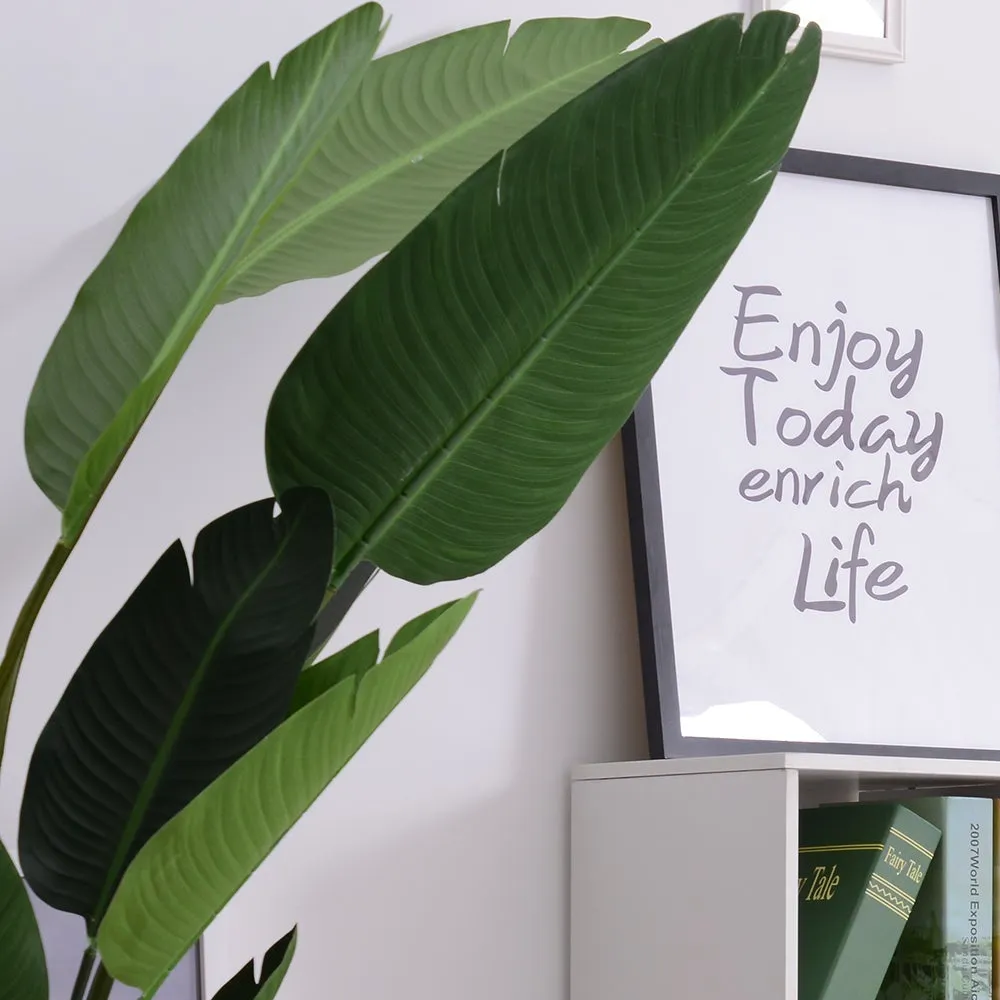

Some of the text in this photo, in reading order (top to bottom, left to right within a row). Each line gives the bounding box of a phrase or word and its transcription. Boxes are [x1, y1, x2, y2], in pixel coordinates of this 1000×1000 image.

[733, 284, 924, 399] Enjoy
[719, 366, 944, 482] Today
[739, 452, 912, 513] enrich
[793, 522, 908, 624] Life
[805, 864, 840, 901] Tale
[884, 846, 923, 884] Fairy Tale
[968, 901, 980, 974] Exposition
